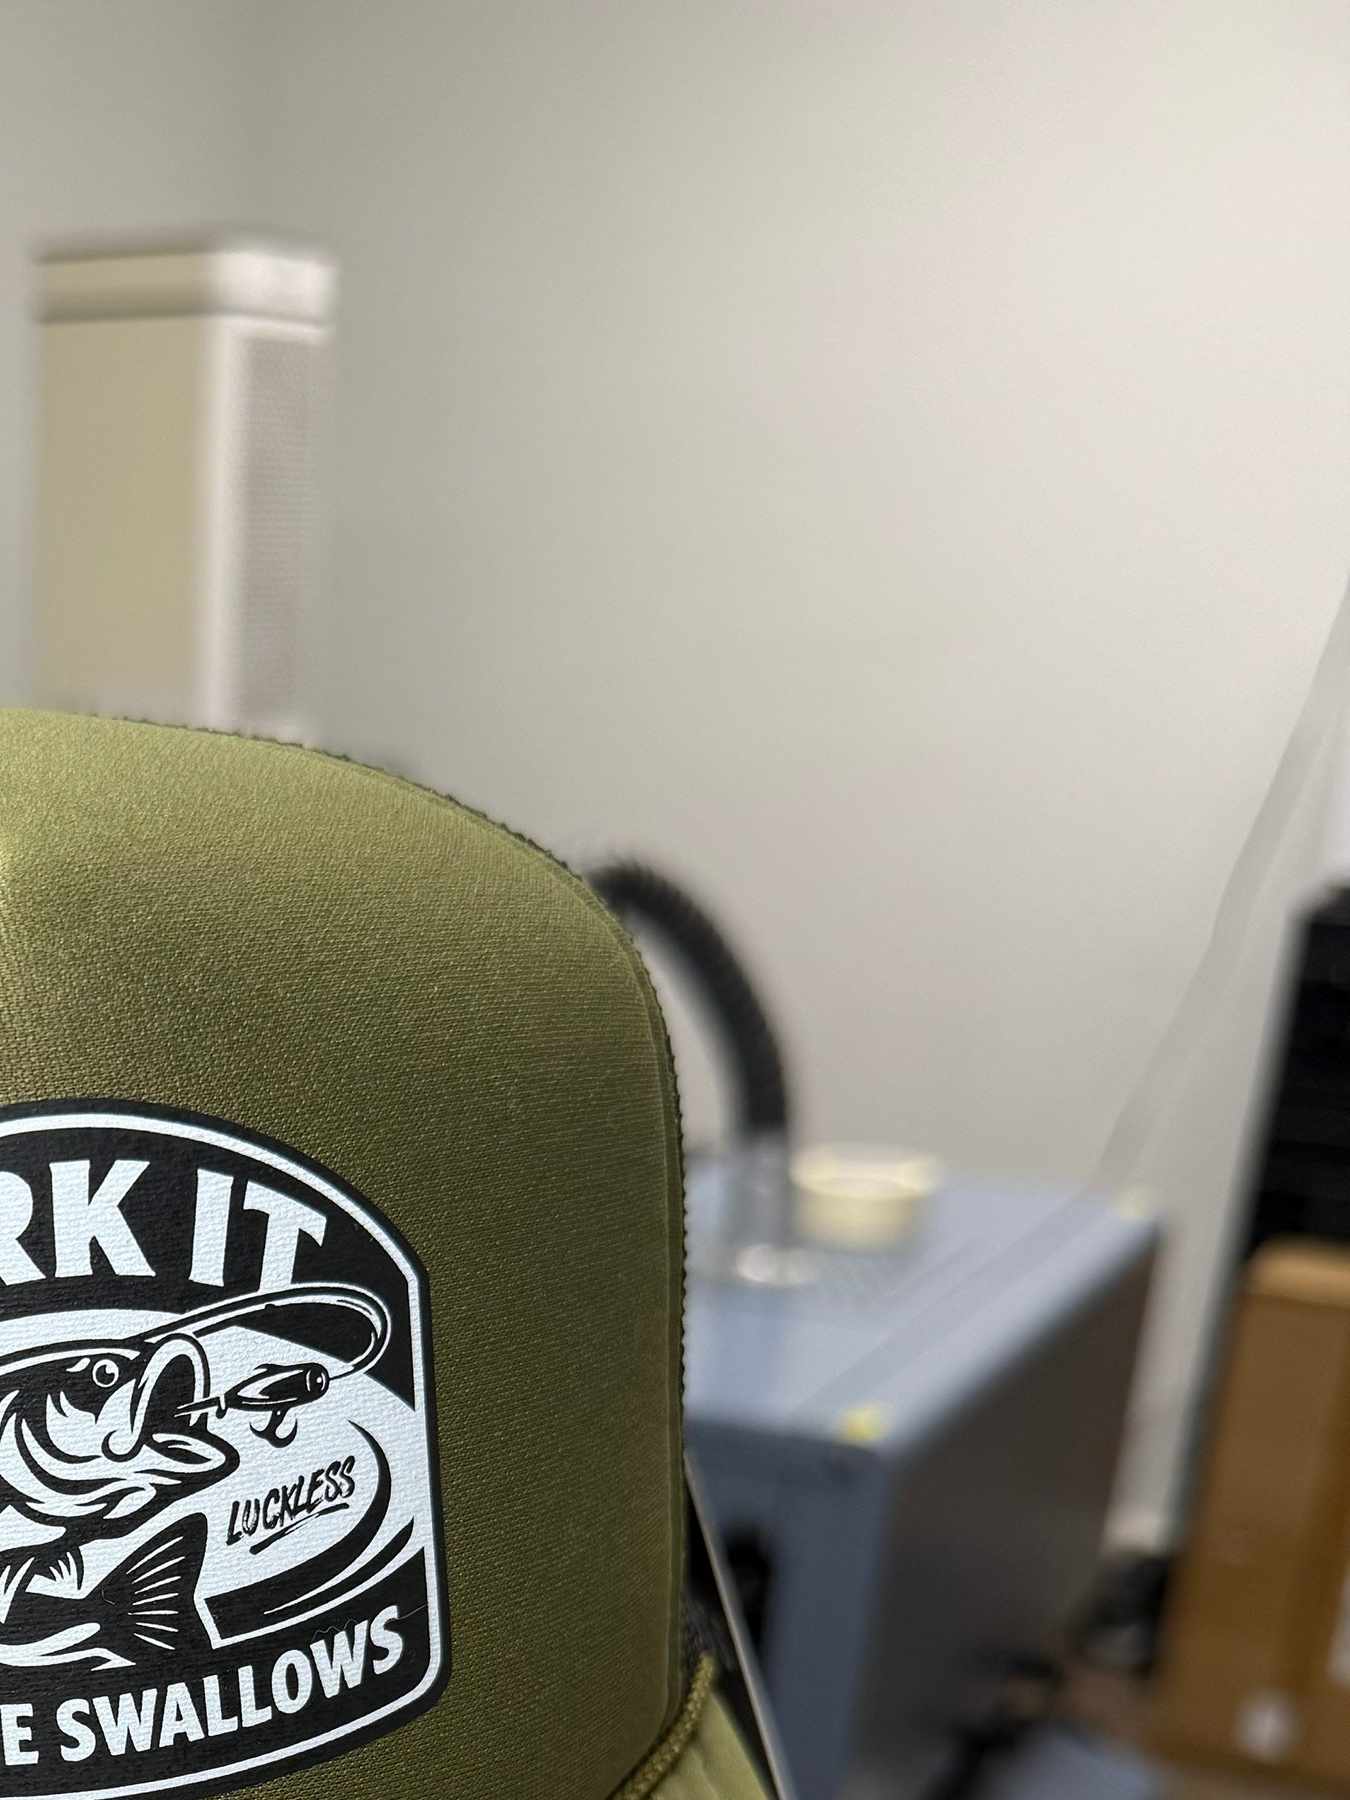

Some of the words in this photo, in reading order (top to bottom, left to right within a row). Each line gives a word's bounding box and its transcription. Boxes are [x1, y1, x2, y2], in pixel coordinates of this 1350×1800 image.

[188, 1168, 328, 1292] IT
[225, 1455, 356, 1546] LUCKLESS
[58, 1604, 407, 1760] SWALLOWS
